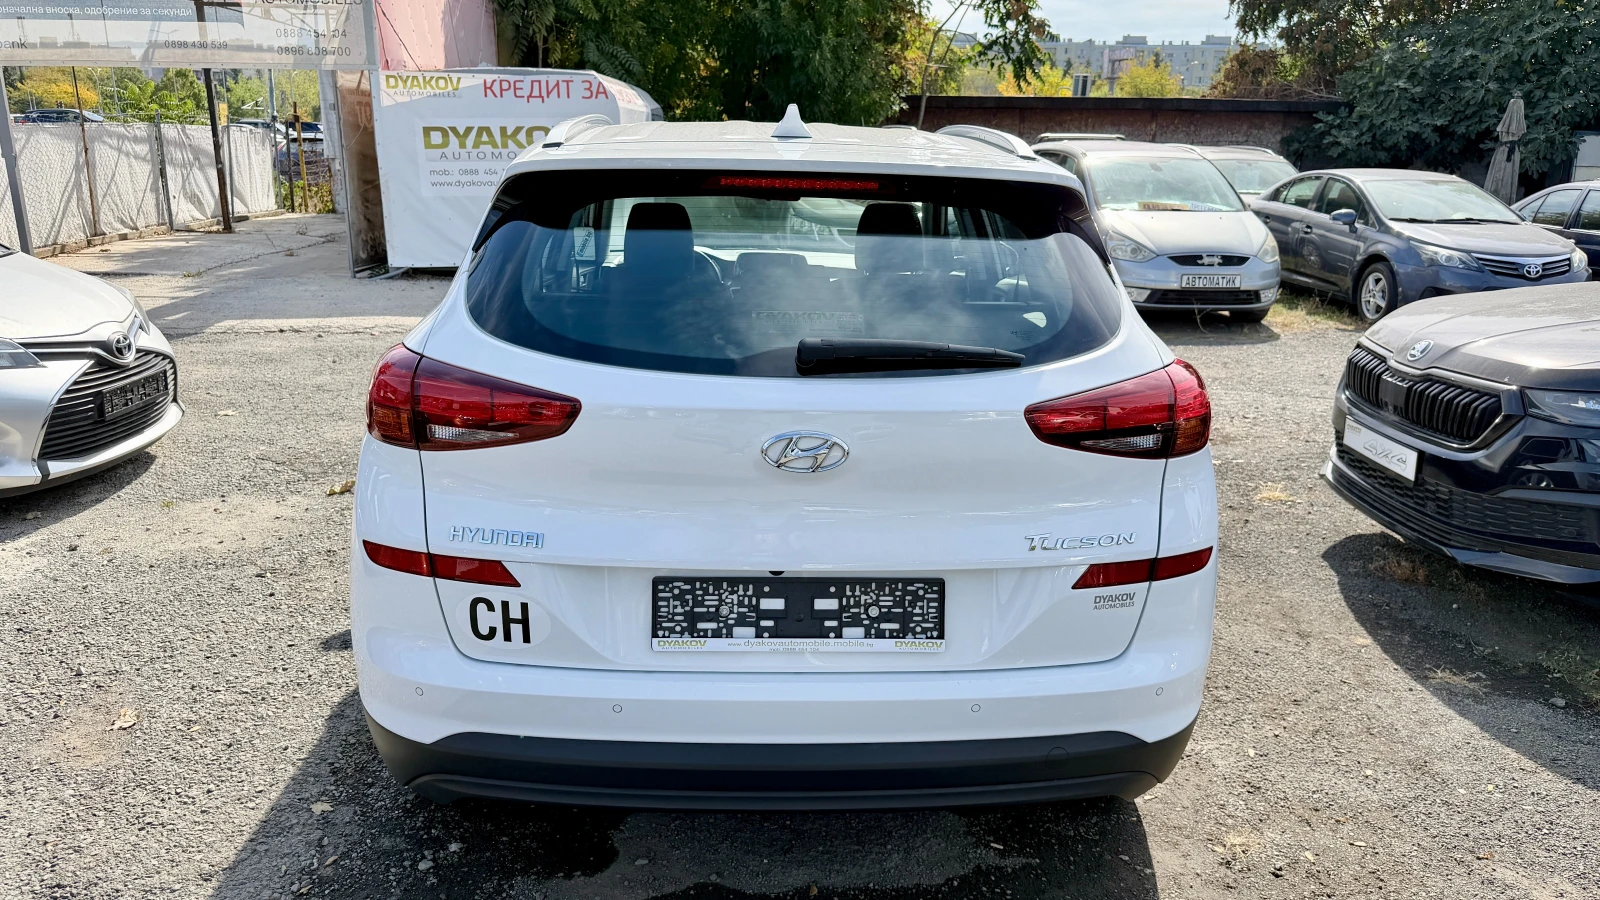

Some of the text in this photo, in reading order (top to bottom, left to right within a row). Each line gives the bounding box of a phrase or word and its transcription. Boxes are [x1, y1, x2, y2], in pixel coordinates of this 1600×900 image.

[85, 6, 138, 16] одобрение
[140, 7, 151, 15] за
[153, 7, 192, 16] секунди
[276, 29, 303, 38] 0888
[306, 29, 327, 38] 454
[164, 40, 228, 50] 0898 430 539
[277, 47, 304, 56] 0896
[331, 47, 352, 57] 700
[385, 75, 461, 91] DYAKOV
[393, 90, 457, 98] AUTOMOBILES
[483, 79, 574, 103] КРЕДИТ
[581, 79, 609, 100] ЗА
[422, 125, 552, 150] DYAKO
[458, 168, 480, 177] 0888
[483, 168, 499, 176] 454
[430, 180, 500, 189] www.dyakovau
[1185, 276, 1237, 288] АВТОМАТИК
[449, 525, 545, 549] HYUNDAI
[1025, 532, 1137, 551] TUCSON
[1093, 592, 1136, 604] DYAKOV
[1093, 601, 1135, 610] AUTOMOBILES
[469, 596, 531, 644] CH
[894, 640, 943, 648] DYAKOV
